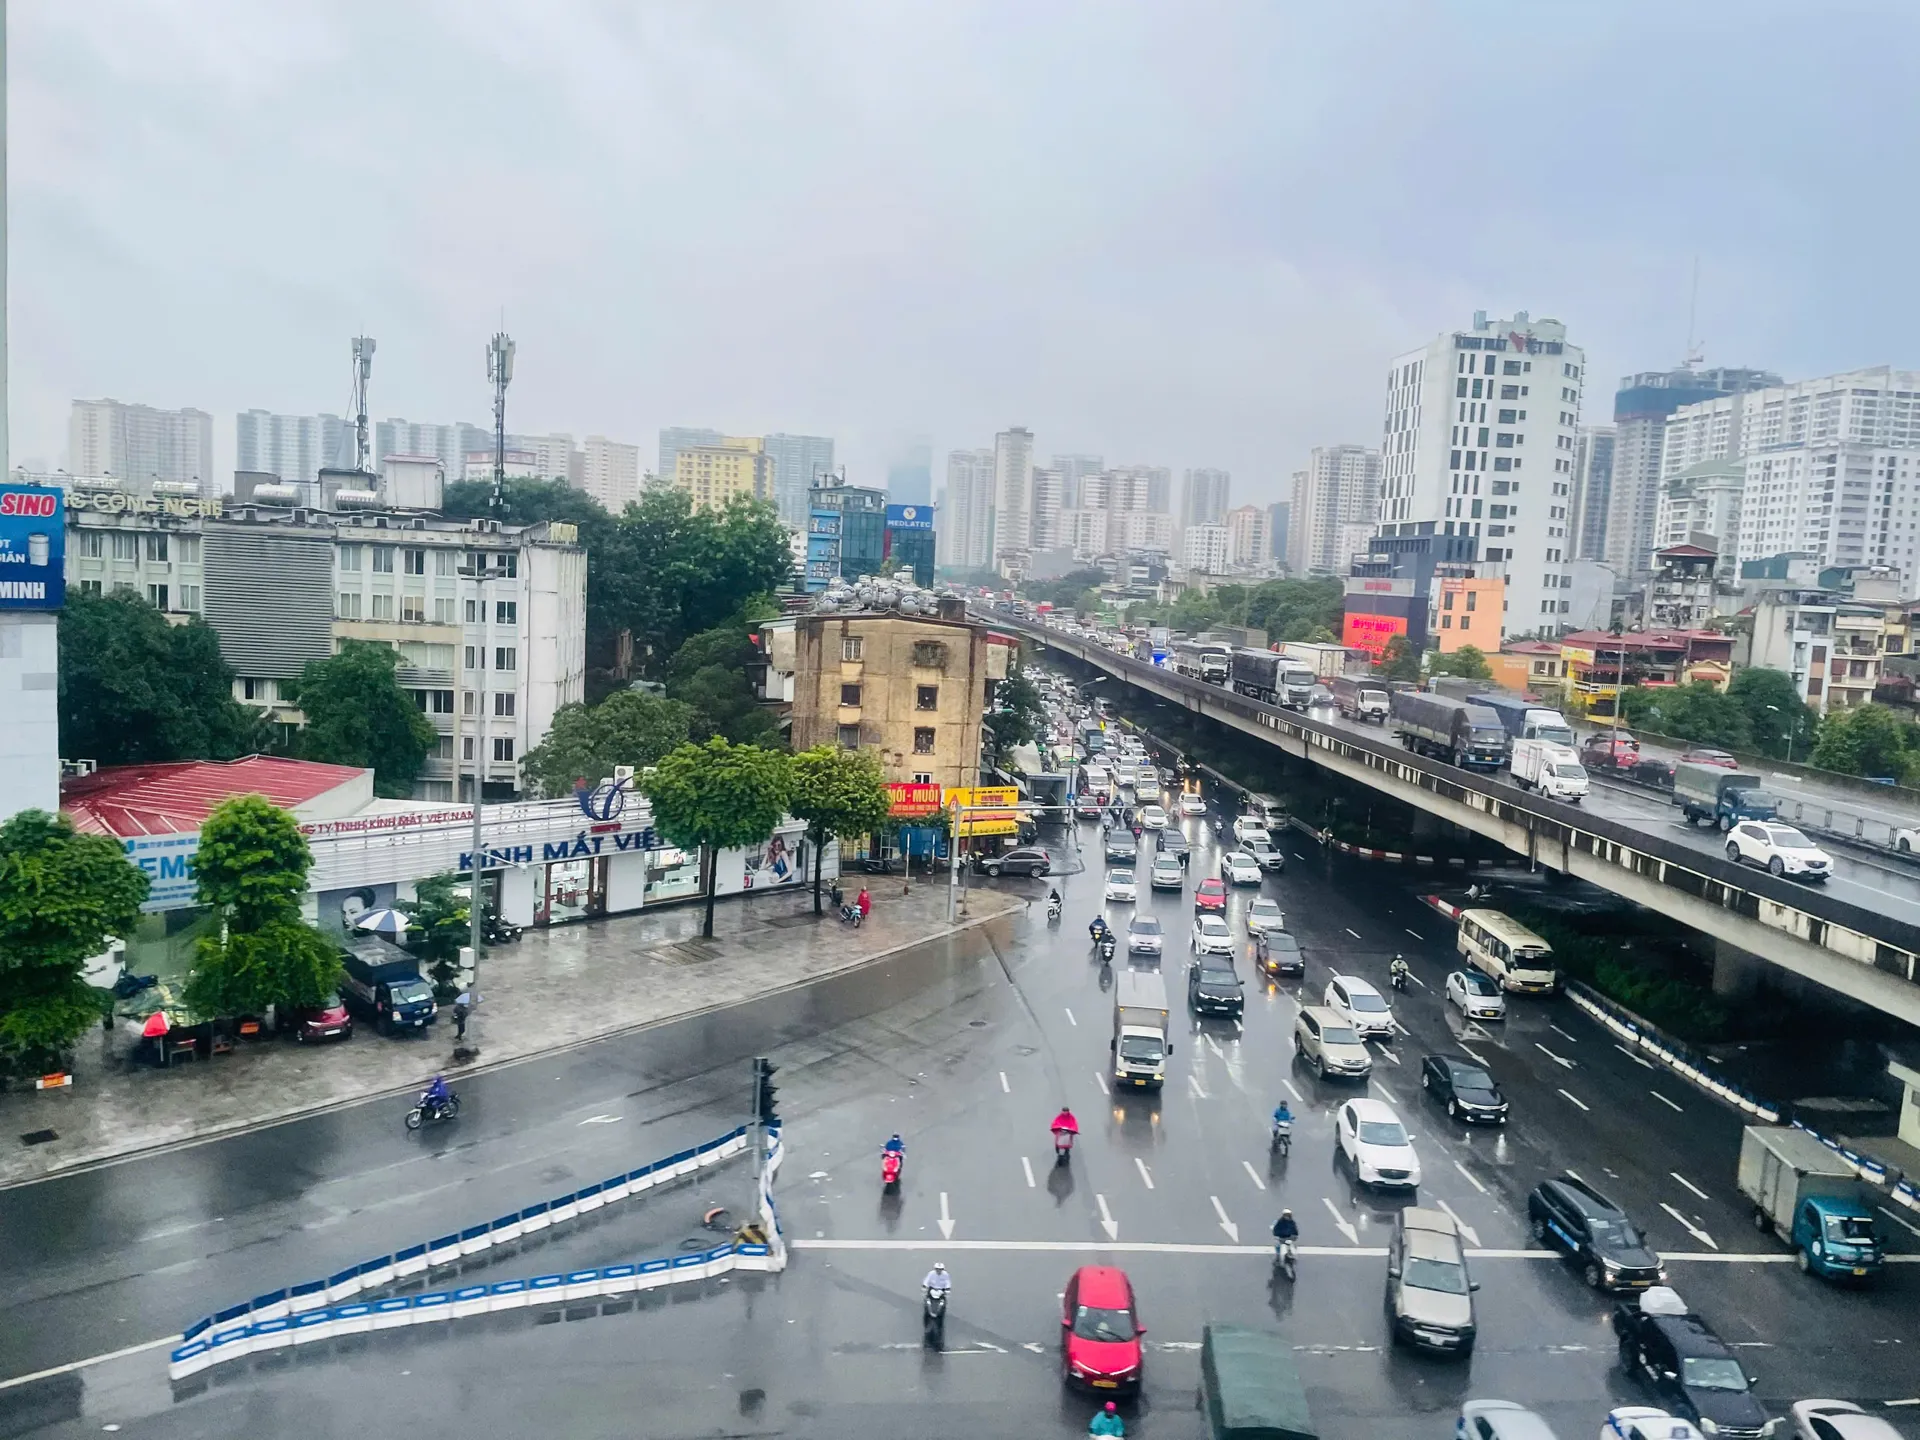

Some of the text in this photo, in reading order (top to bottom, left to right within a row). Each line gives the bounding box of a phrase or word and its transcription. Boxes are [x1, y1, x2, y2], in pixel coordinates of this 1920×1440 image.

[1, 493, 56, 517] SINO
[887, 520, 931, 528] MEDLATEC
[0, 537, 11, 549] T
[0, 551, 25, 563] IÃN
[0, 581, 45, 599] MINH
[318, 823, 333, 834] TY
[459, 843, 533, 871] KÍNH
[543, 831, 605, 860] MẮT
